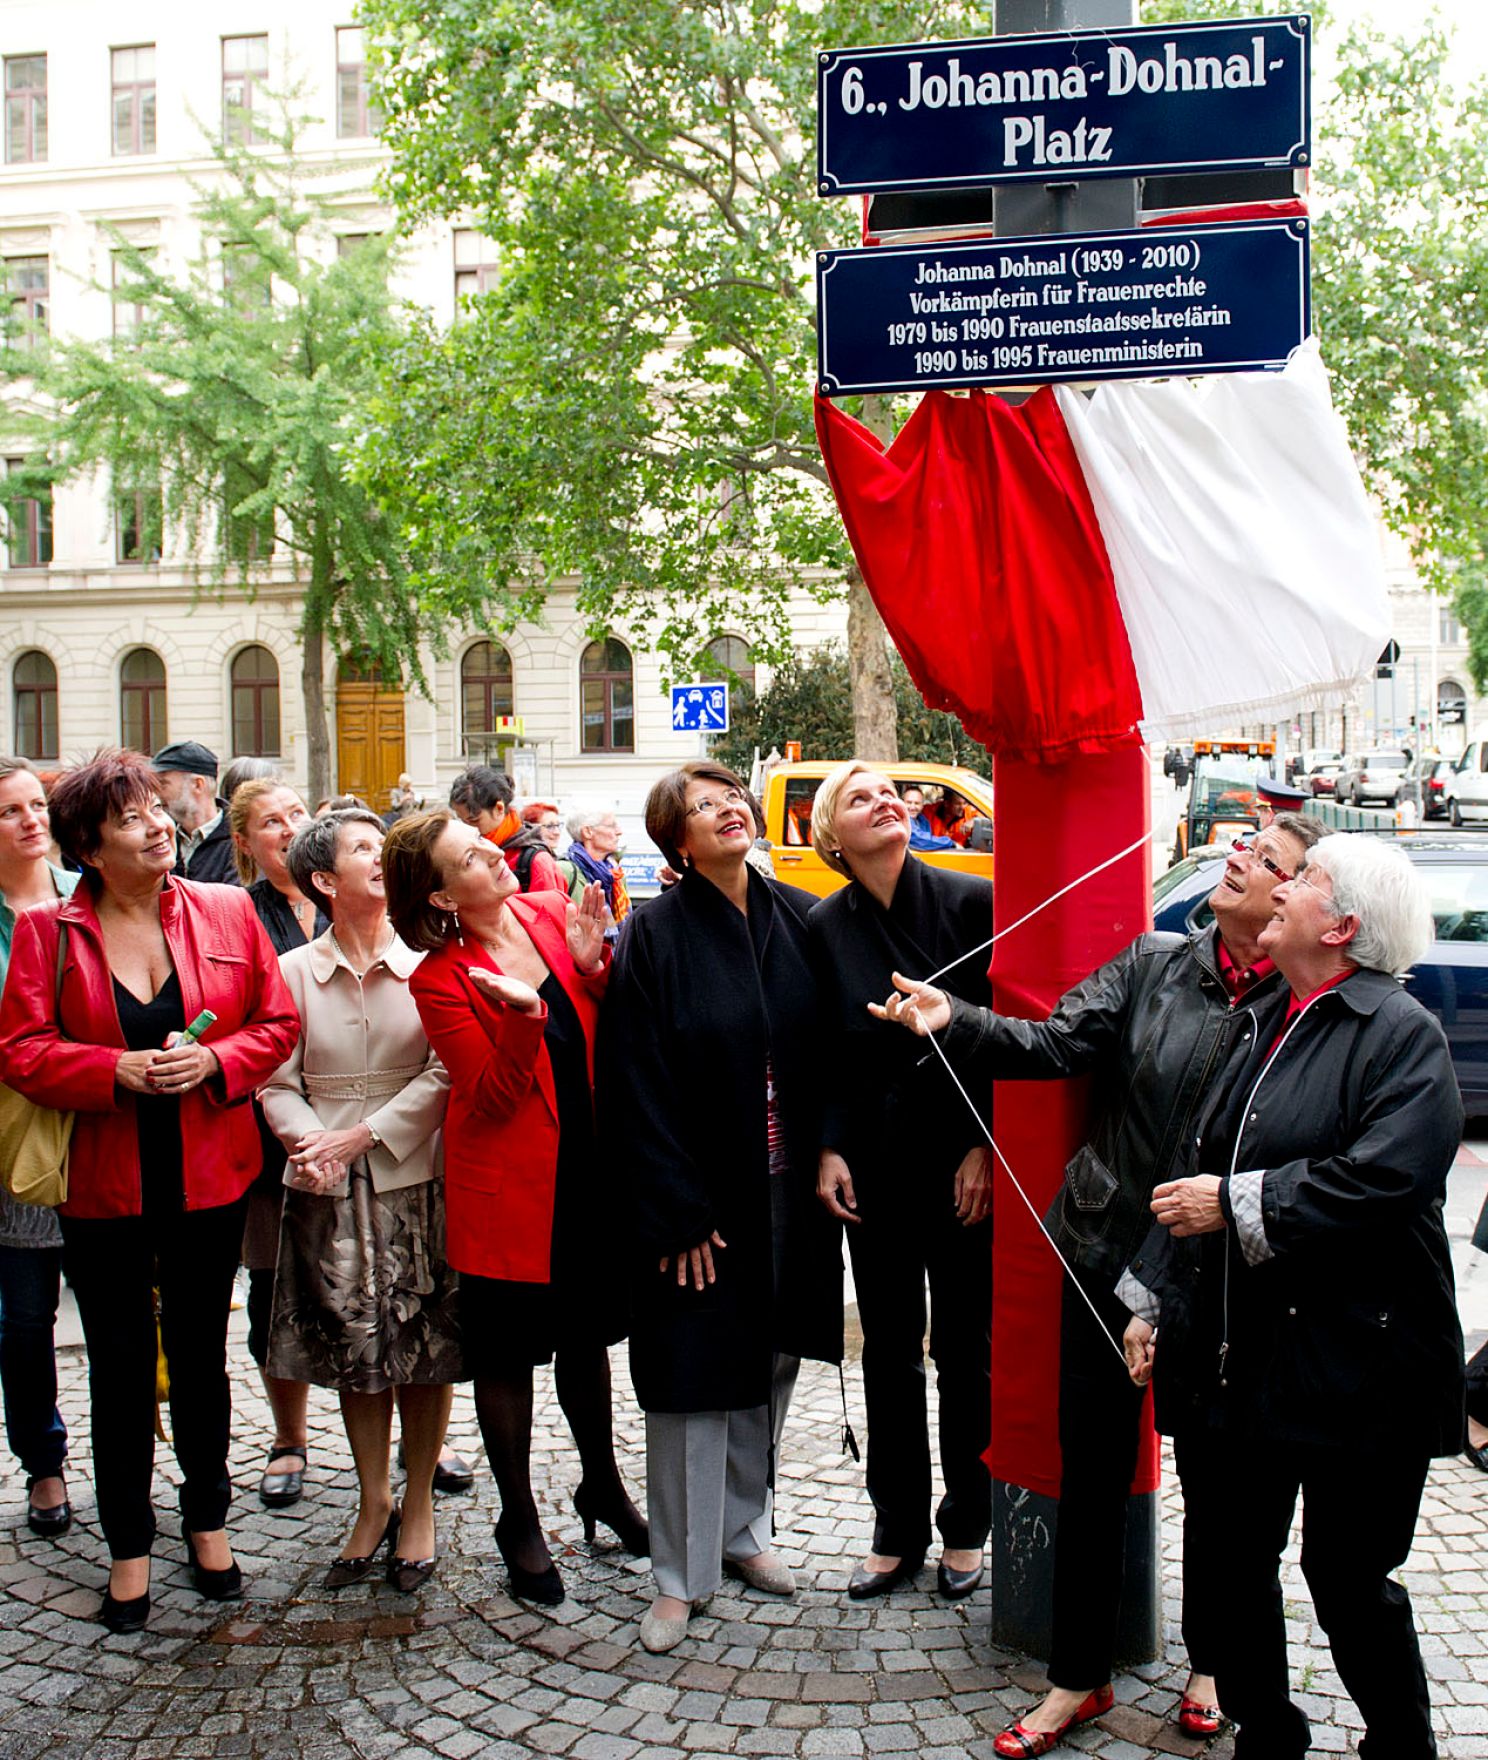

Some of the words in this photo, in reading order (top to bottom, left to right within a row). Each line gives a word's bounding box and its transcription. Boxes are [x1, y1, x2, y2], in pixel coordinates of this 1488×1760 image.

[841, 66, 888, 116] 6.,
[898, 35, 1284, 111] Johanna-Dohnal-
[1002, 115, 1113, 167] Platz
[914, 261, 996, 285] Johanna
[999, 252, 1067, 279] Dohnal
[1071, 247, 1124, 279] (1939
[1141, 239, 1201, 272] 2010)
[909, 287, 1039, 317] Vorkämpferin
[1042, 283, 1073, 306] für
[1076, 274, 1207, 304] Frauenrechte
[887, 321, 927, 346] 1979
[930, 321, 958, 343] bis
[960, 317, 1005, 341] 1990
[1008, 304, 1231, 338] Frauenstaatssekretärin
[914, 350, 957, 374] 1990
[961, 349, 989, 371] bis
[991, 345, 1033, 369] 1995
[1037, 338, 1204, 366] Frauenministerin
